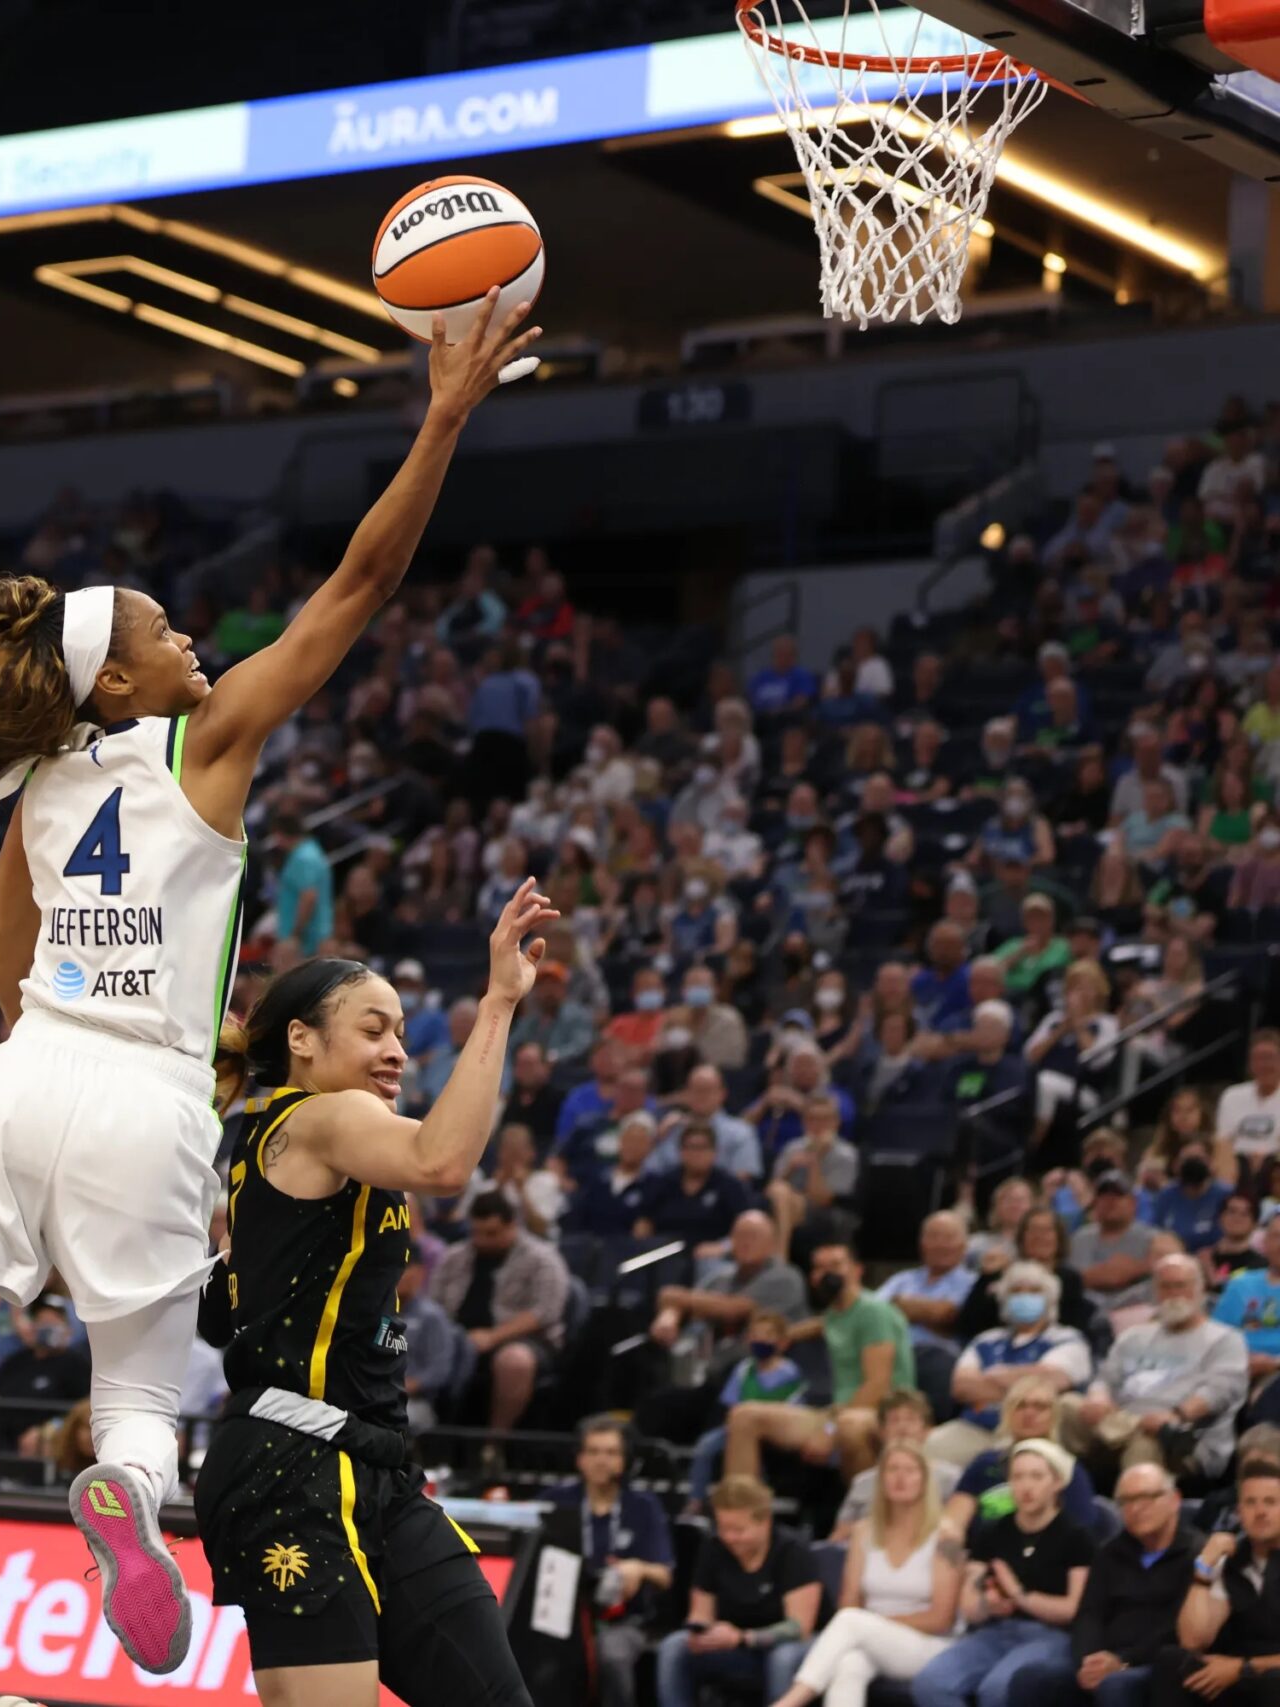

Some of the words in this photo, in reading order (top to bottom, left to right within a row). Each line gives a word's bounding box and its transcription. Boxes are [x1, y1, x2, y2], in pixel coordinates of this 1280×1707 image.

[392, 191, 503, 241] Wilson
[63, 787, 130, 896] 4
[48, 907, 162, 946] JEFFERSON
[91, 969, 156, 997] AT&T
